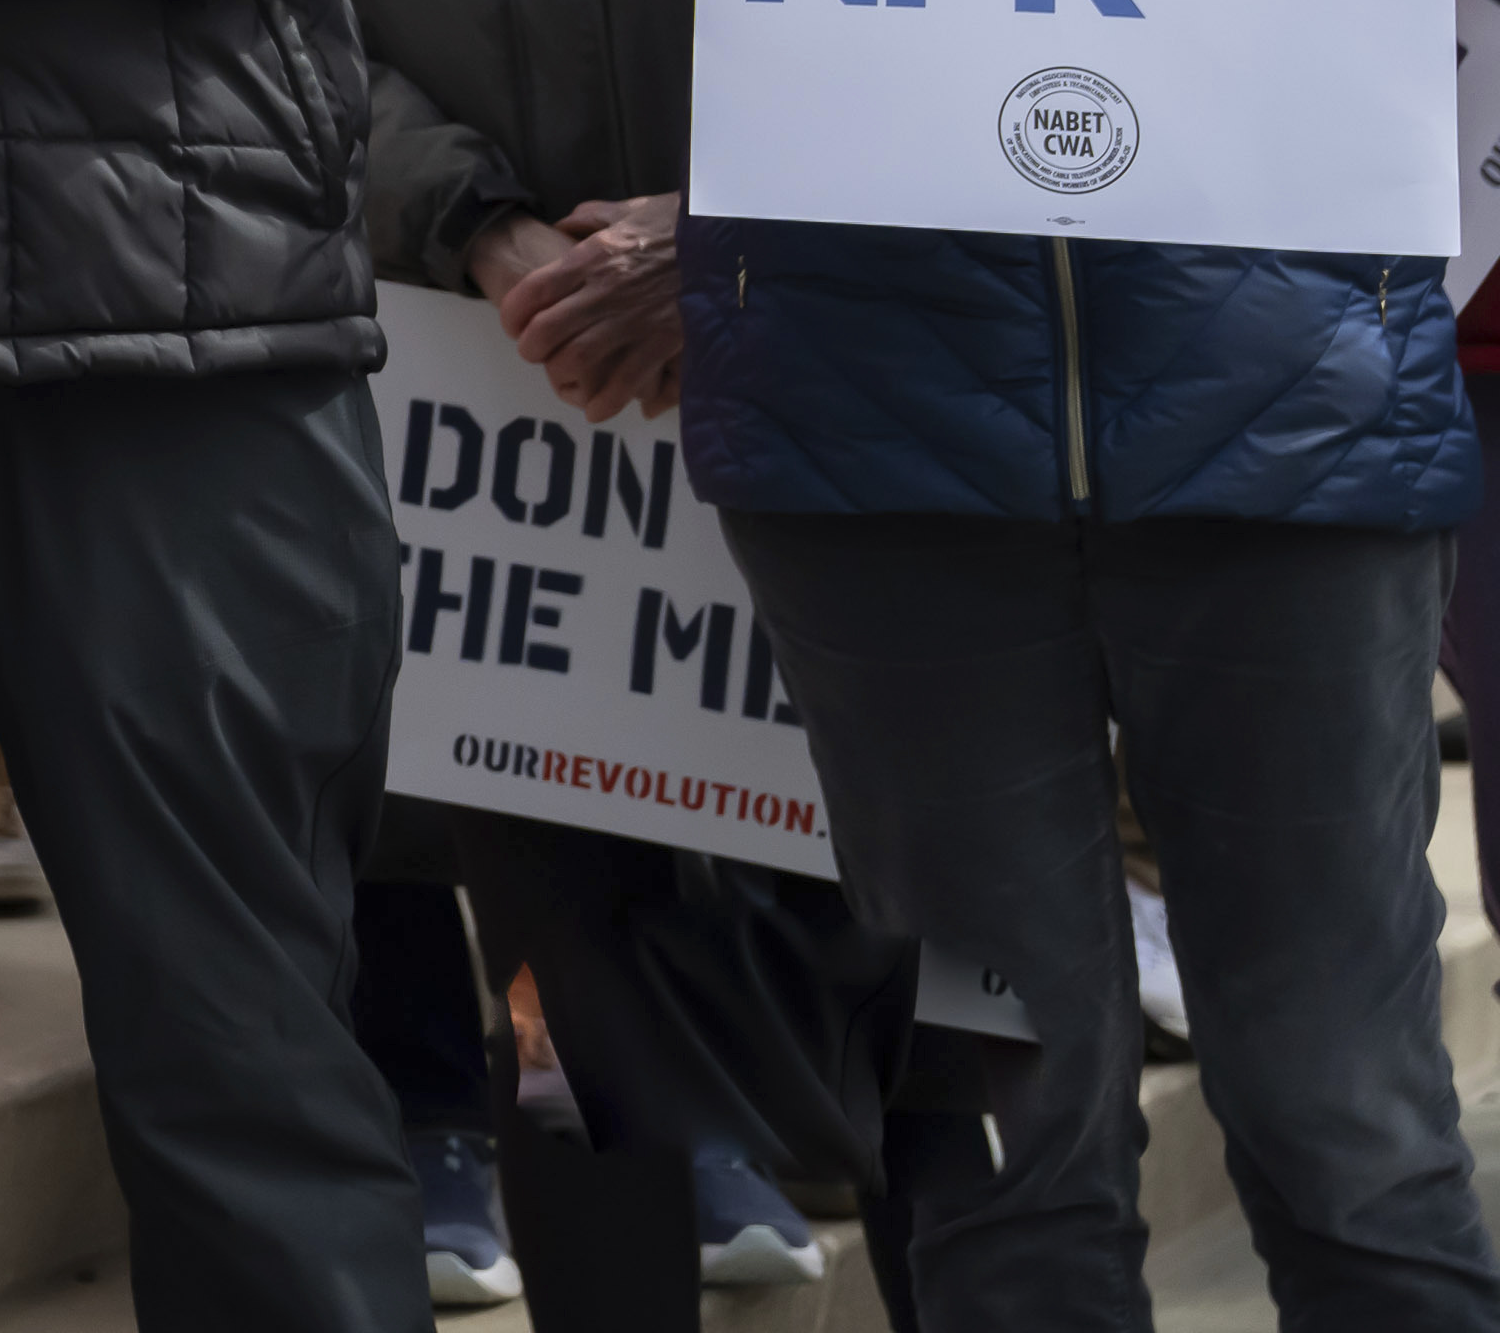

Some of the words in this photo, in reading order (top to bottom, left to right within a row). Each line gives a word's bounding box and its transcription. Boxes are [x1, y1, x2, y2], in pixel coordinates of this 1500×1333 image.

[1033, 108, 1104, 134] NABET
[1043, 133, 1095, 158] CWA
[401, 541, 583, 674] HE
